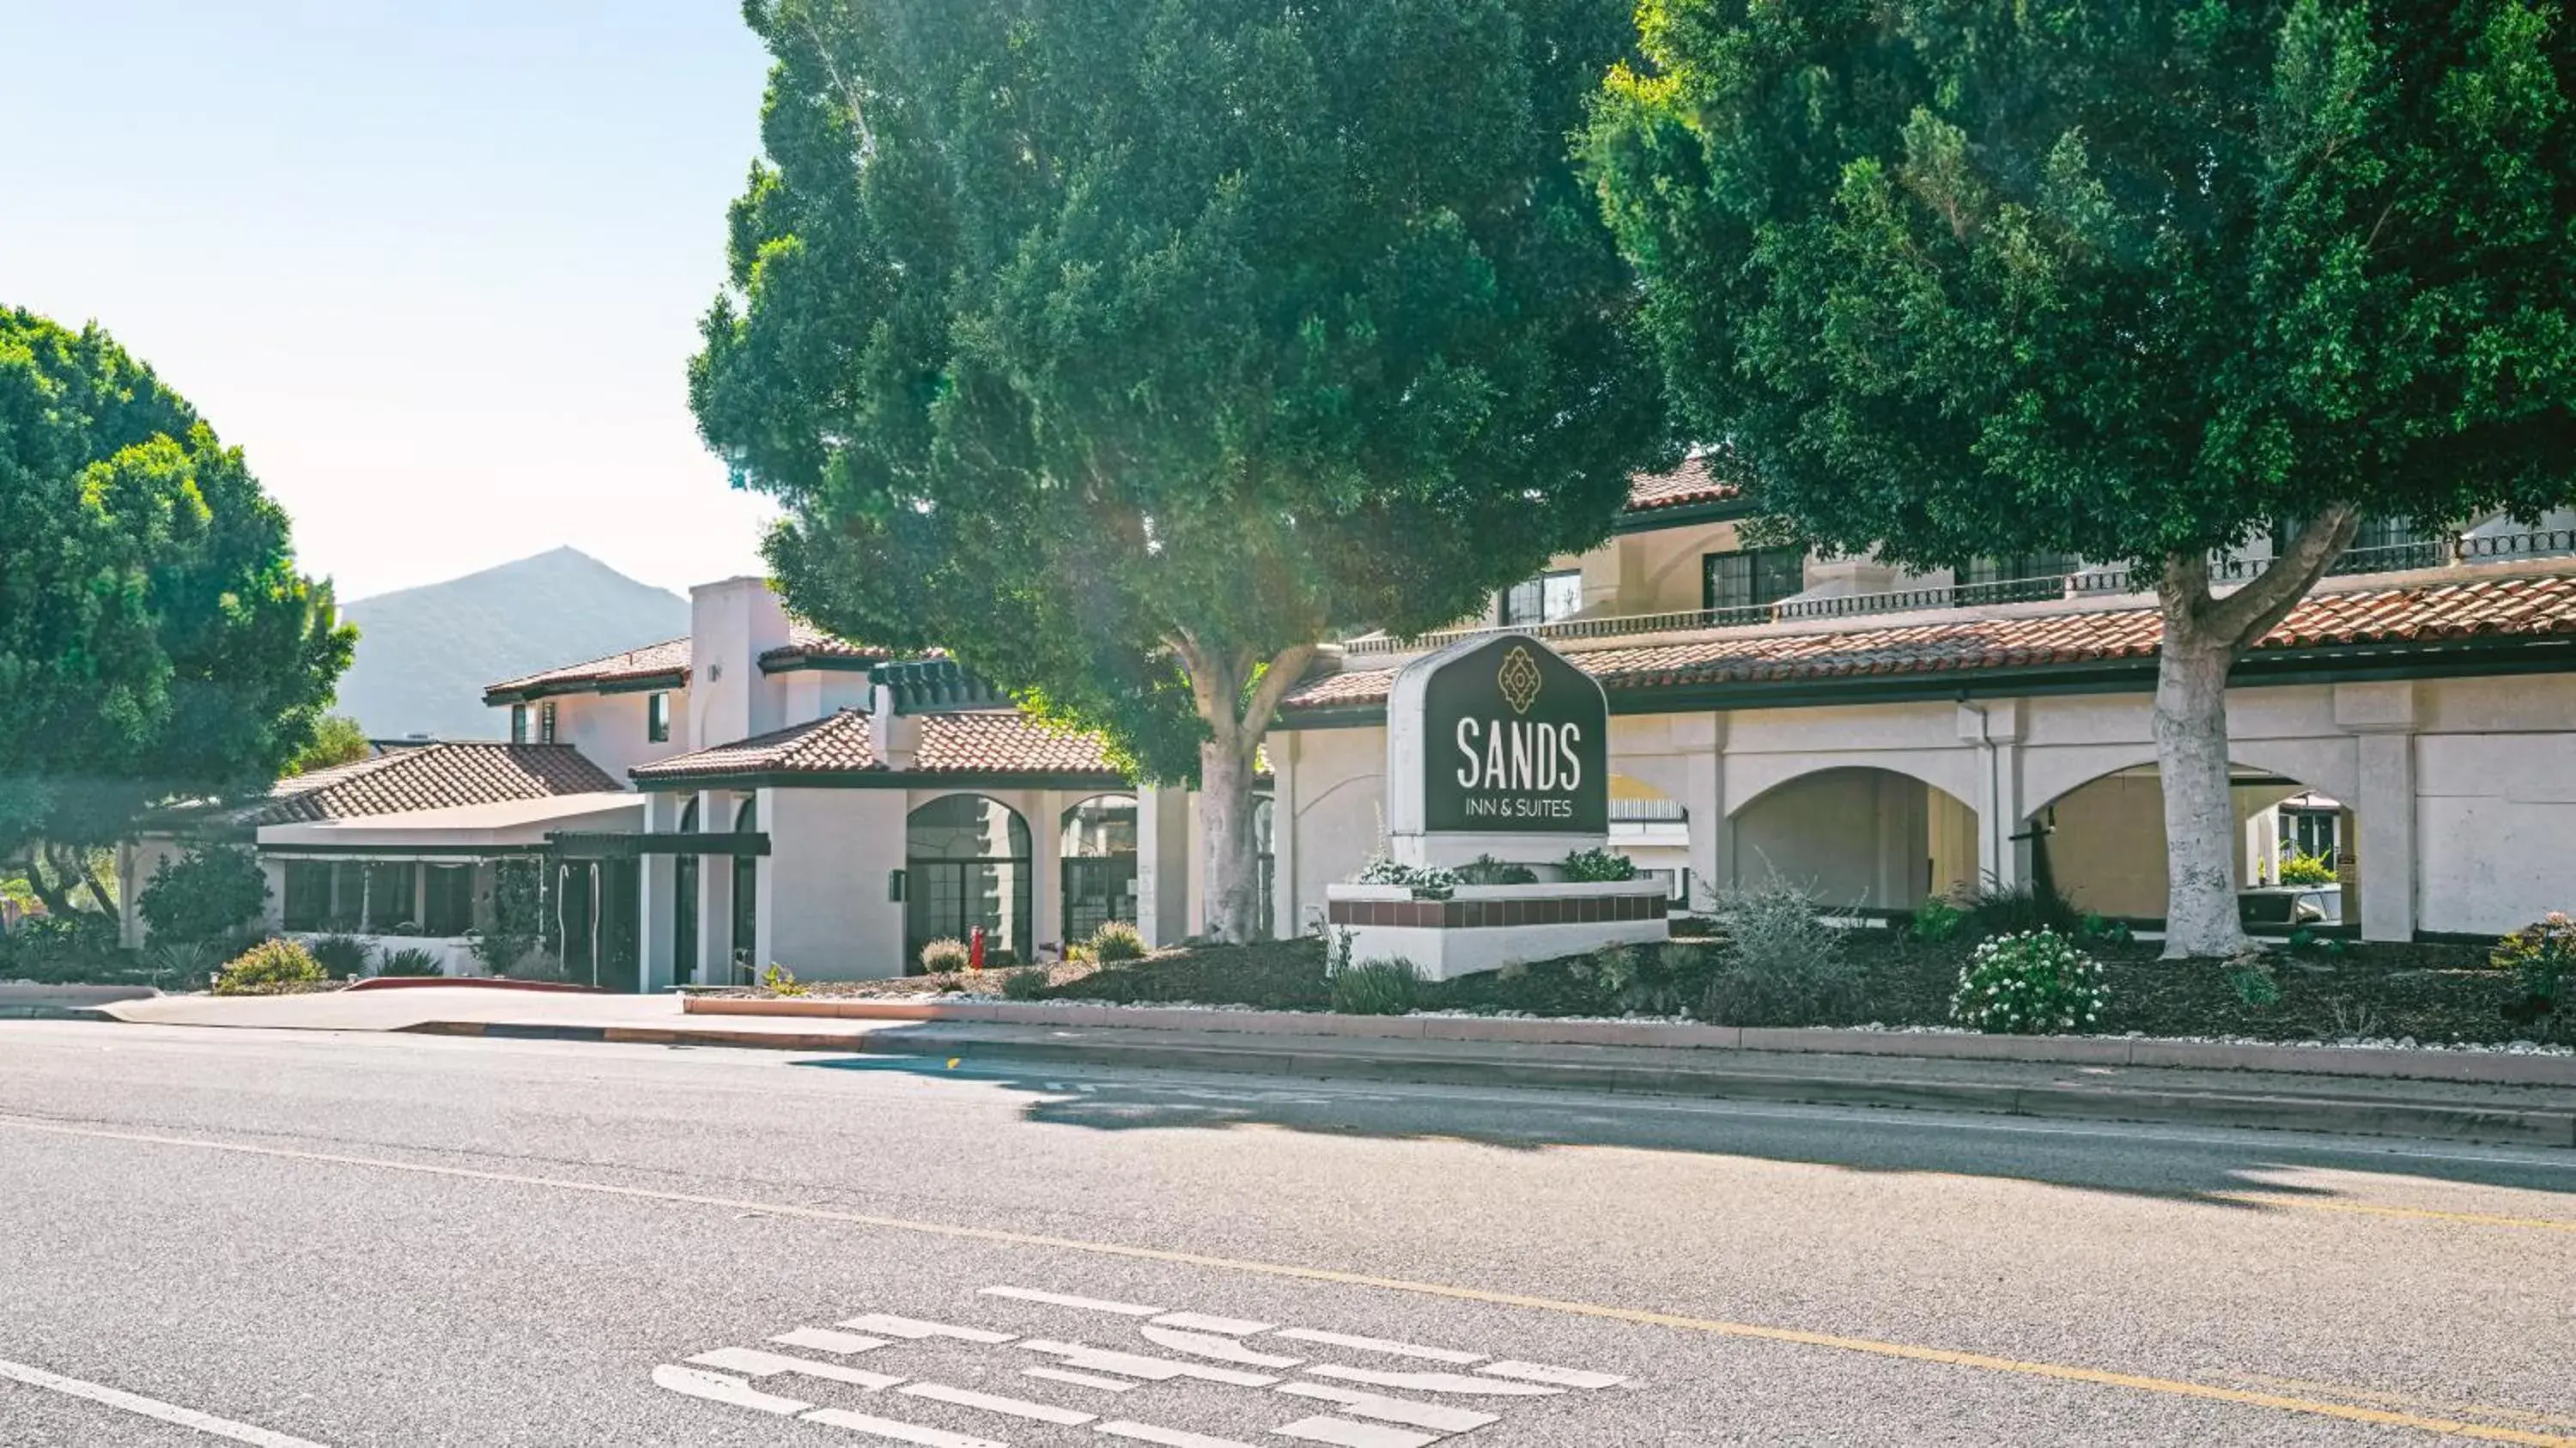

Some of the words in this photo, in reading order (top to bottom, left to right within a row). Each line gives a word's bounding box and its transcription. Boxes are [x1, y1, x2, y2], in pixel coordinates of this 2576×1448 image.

[1456, 716, 1581, 790] SANDS
[1465, 798, 1497, 815] INN
[1501, 798, 1512, 817] &
[1516, 799, 1572, 817] SUITES
